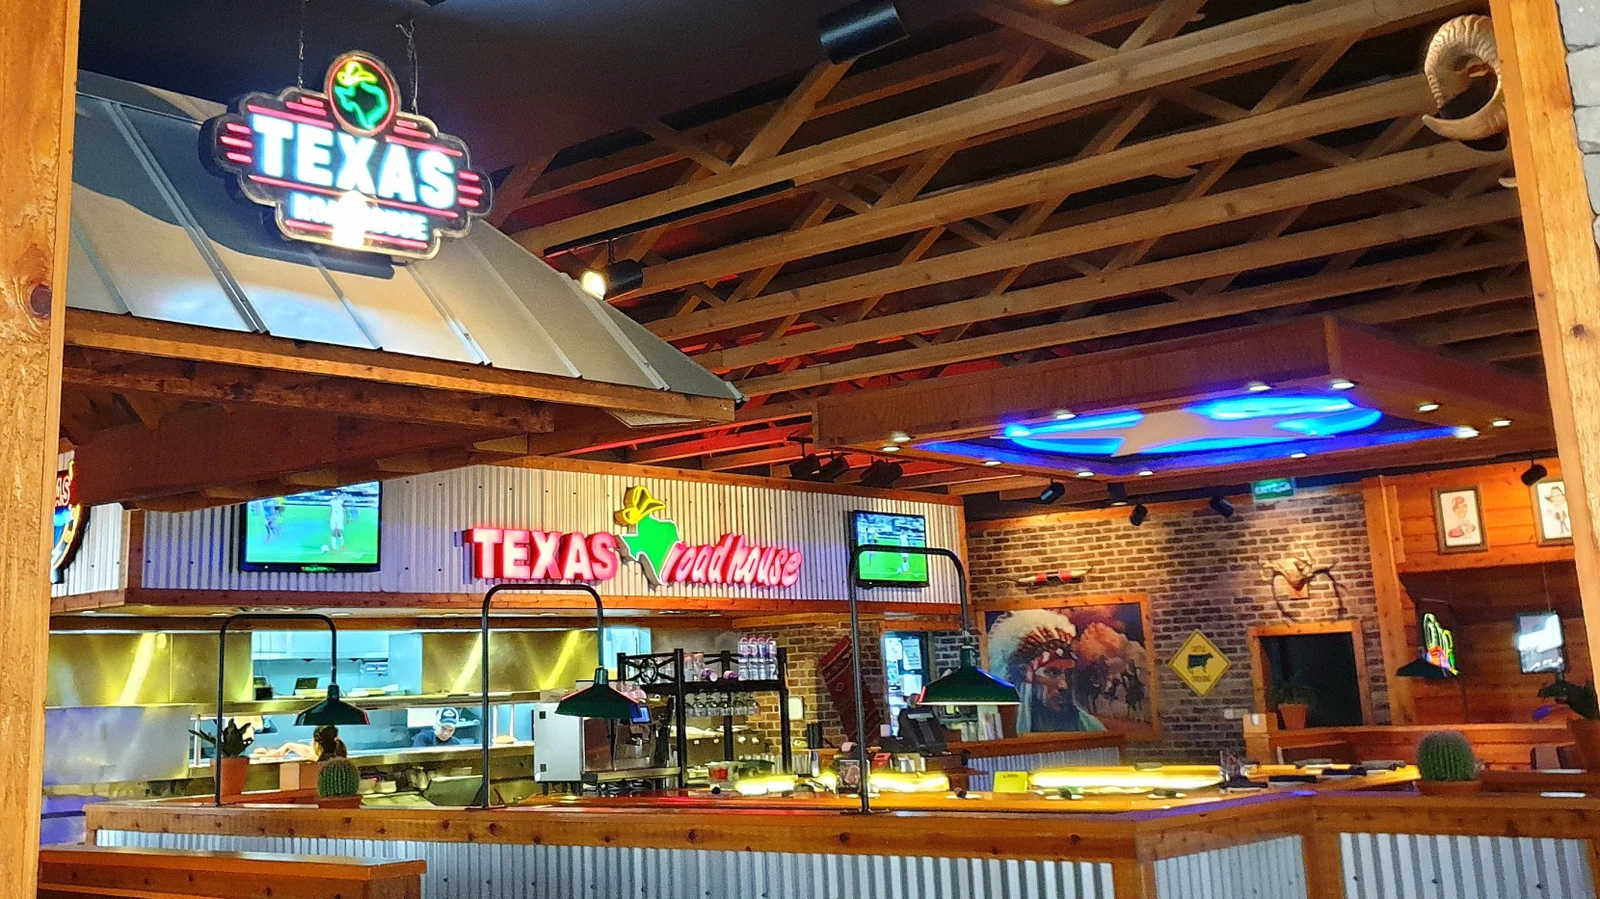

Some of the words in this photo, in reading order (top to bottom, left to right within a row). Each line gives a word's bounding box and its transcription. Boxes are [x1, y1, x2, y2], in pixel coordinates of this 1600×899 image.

[250, 113, 457, 209] TEXAS
[471, 527, 619, 581] TEXAS
[661, 533, 803, 587] roadhouse
